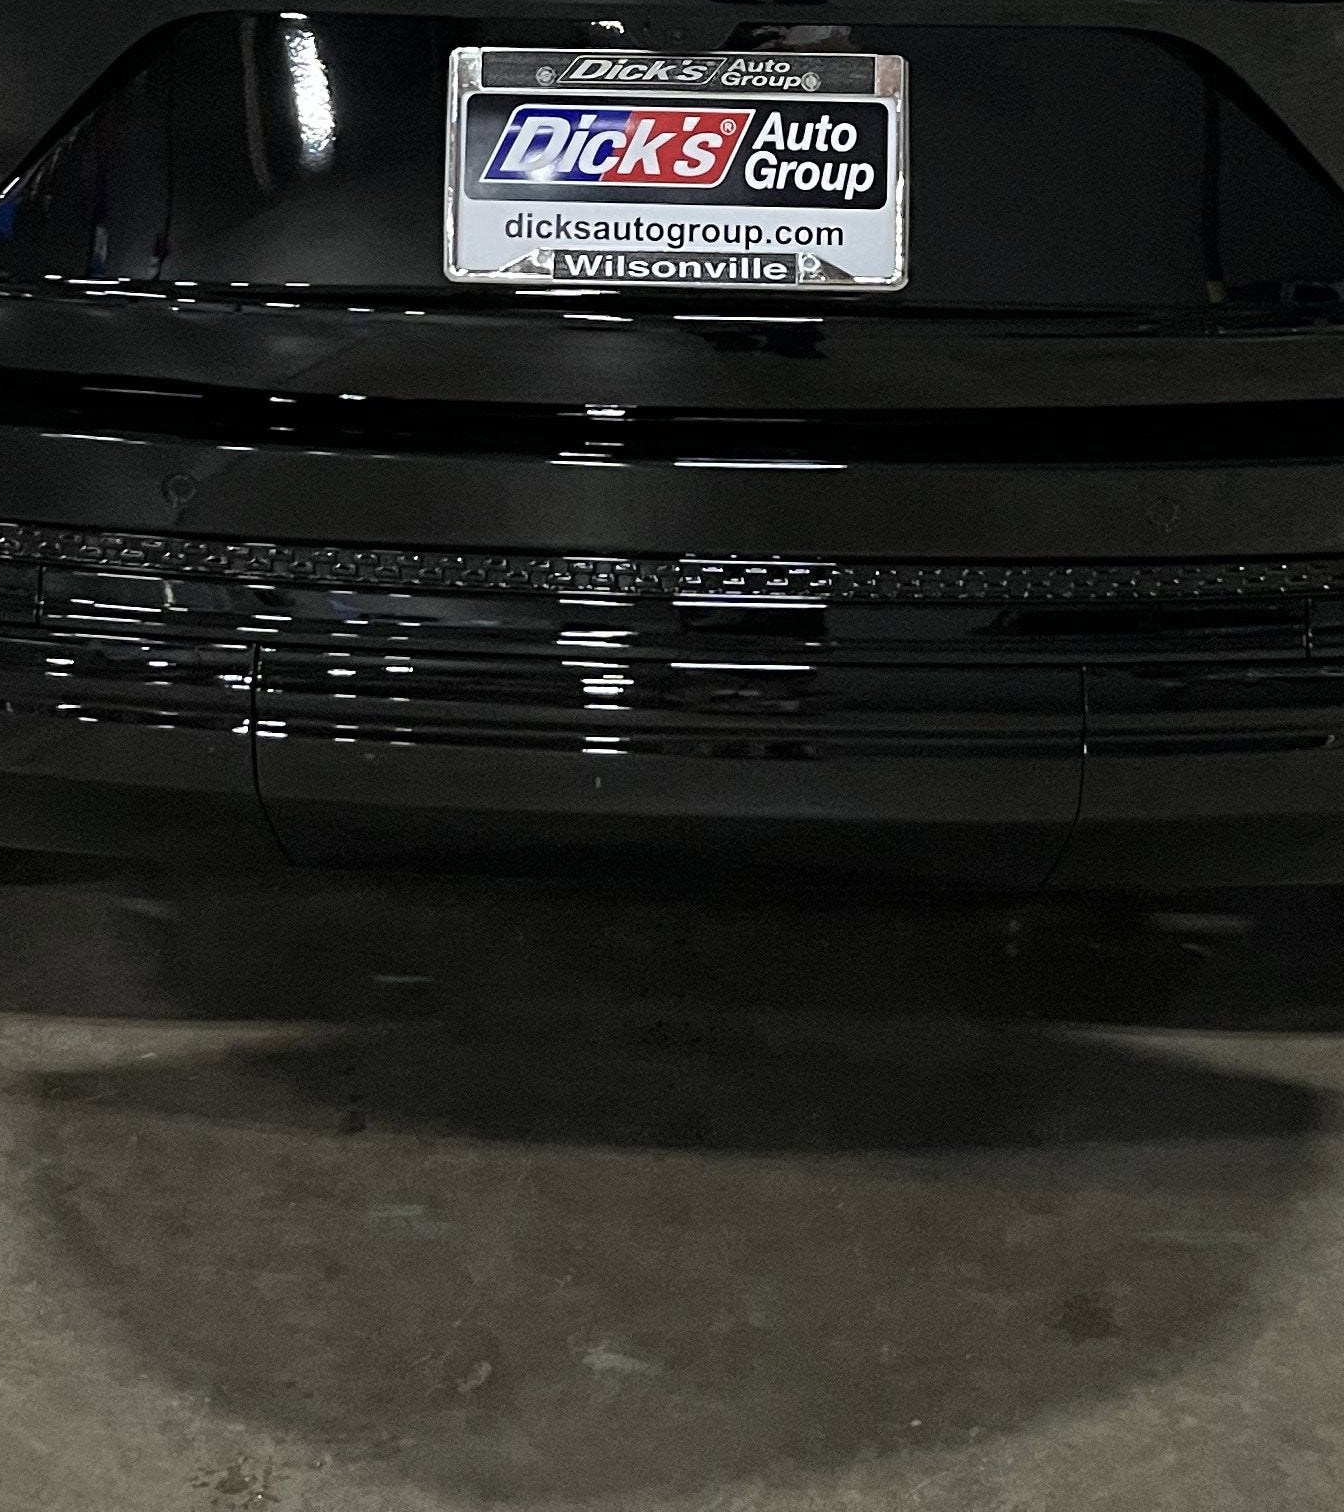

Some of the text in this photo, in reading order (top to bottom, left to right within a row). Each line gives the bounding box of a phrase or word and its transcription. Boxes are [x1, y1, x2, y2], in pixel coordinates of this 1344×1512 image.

[569, 58, 708, 83] Dick's
[720, 72, 802, 90] Group
[727, 58, 791, 73] Auto
[500, 114, 723, 178] Dick's
[752, 111, 857, 152] Auto
[744, 150, 875, 200] Group
[505, 213, 844, 250] dicksautogroup.com
[564, 254, 788, 280] Wilsonville
